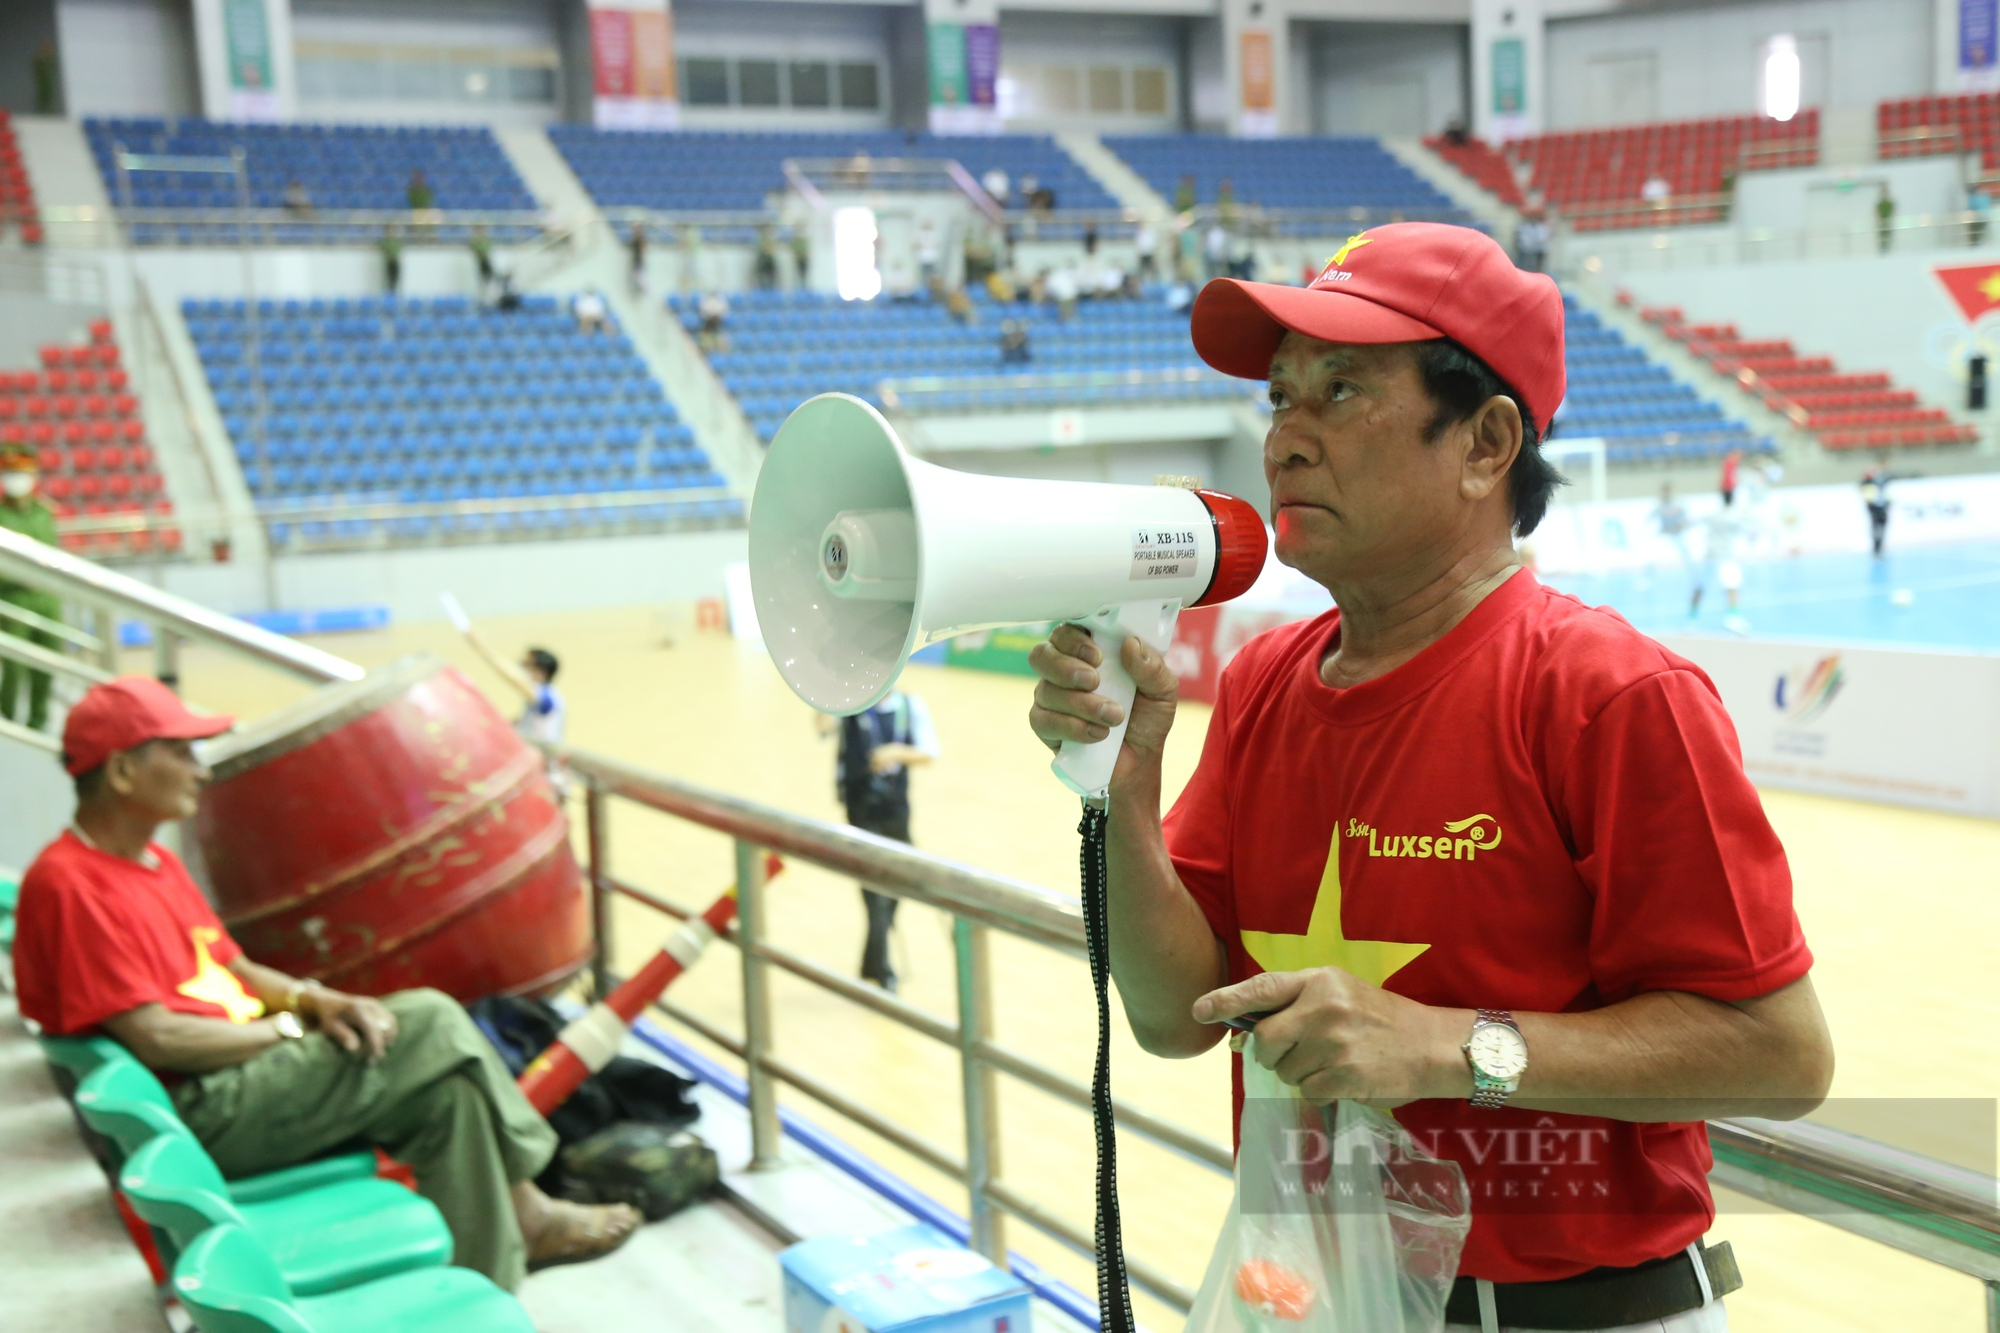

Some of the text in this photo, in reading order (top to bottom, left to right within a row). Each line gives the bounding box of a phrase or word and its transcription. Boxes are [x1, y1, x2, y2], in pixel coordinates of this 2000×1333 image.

[1157, 532, 1194, 544] XB-11S
[1134, 549, 1196, 561] PORTABLE MUSICAL SPEAKER
[1148, 565, 1179, 575] OF BIG POWER
[1368, 828, 1476, 861] Luxsen
